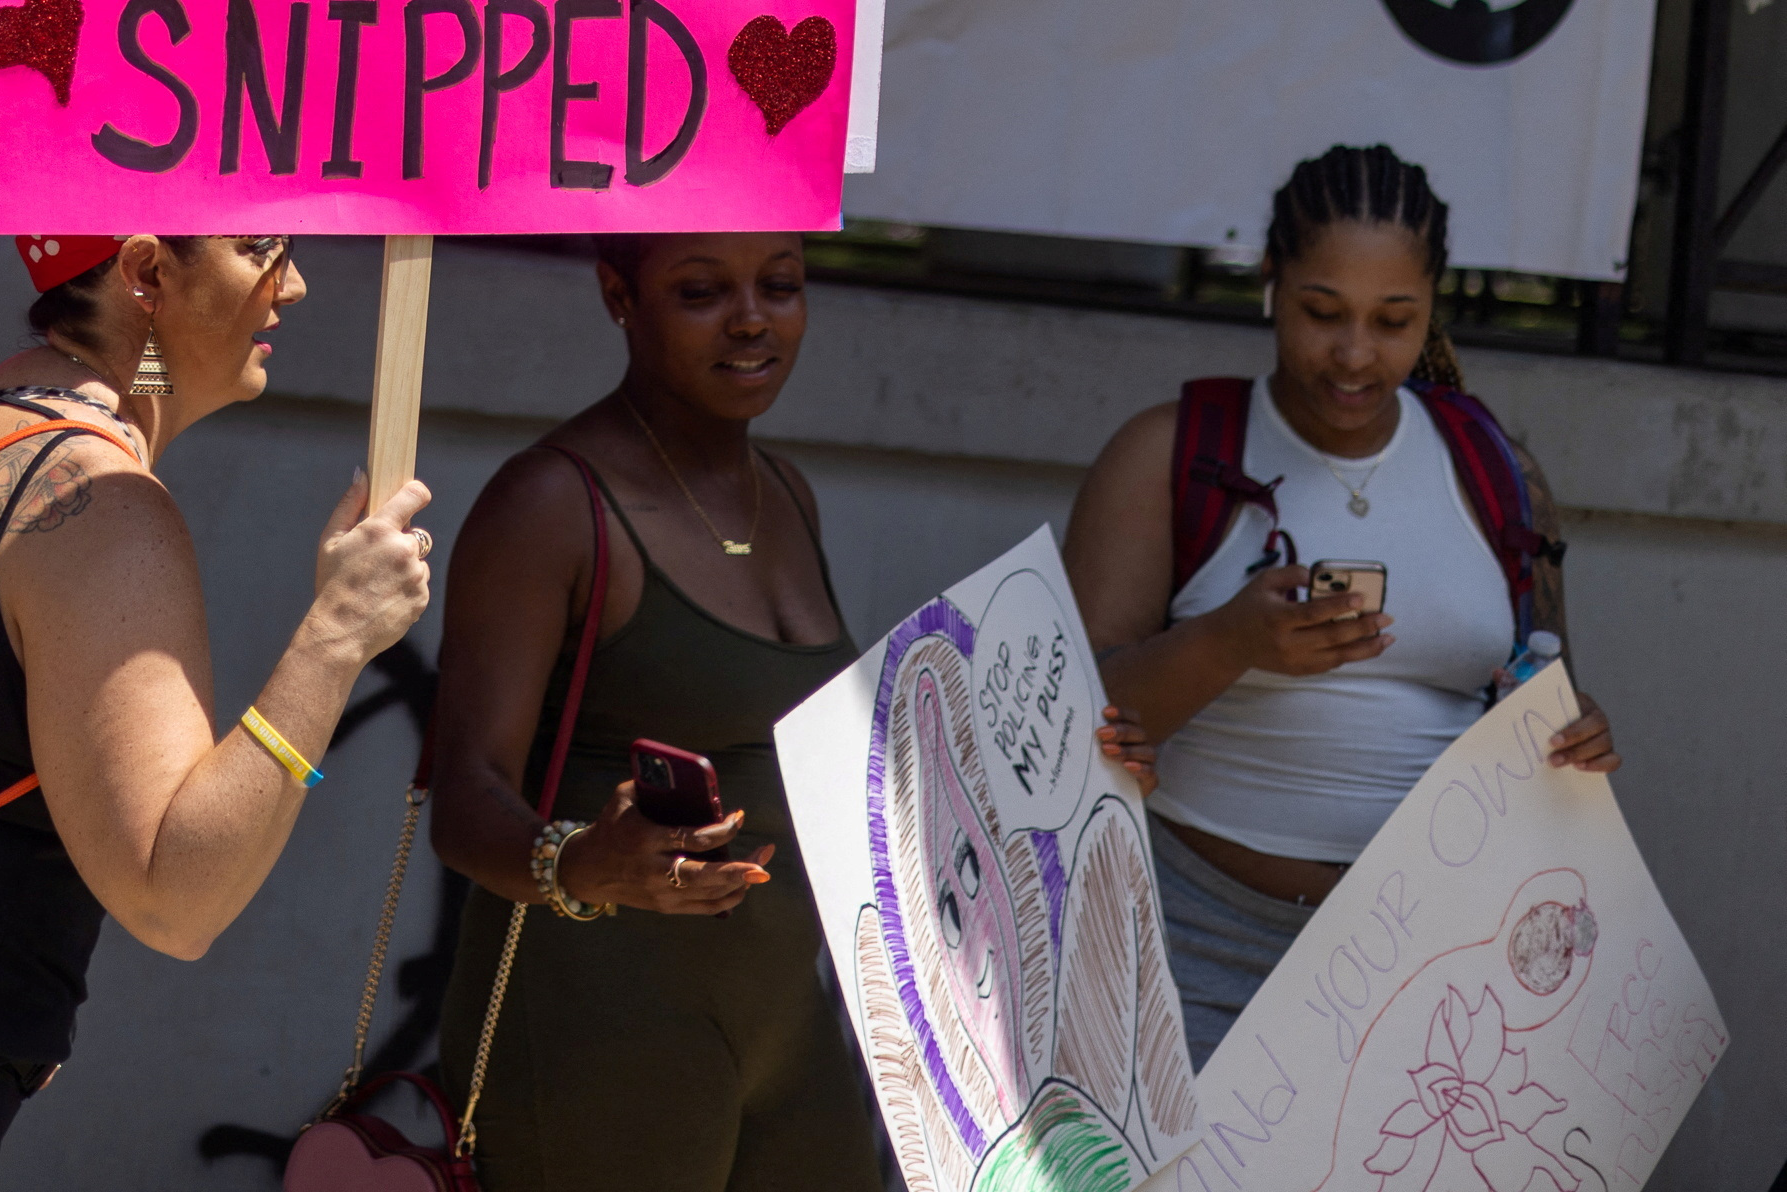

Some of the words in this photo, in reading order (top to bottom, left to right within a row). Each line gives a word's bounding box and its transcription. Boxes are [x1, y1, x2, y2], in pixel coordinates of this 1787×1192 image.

[979, 640, 1014, 729] STOP
[994, 634, 1043, 760] POLICING
[1012, 724, 1047, 797] MY
[1037, 619, 1068, 728] PUSSY
